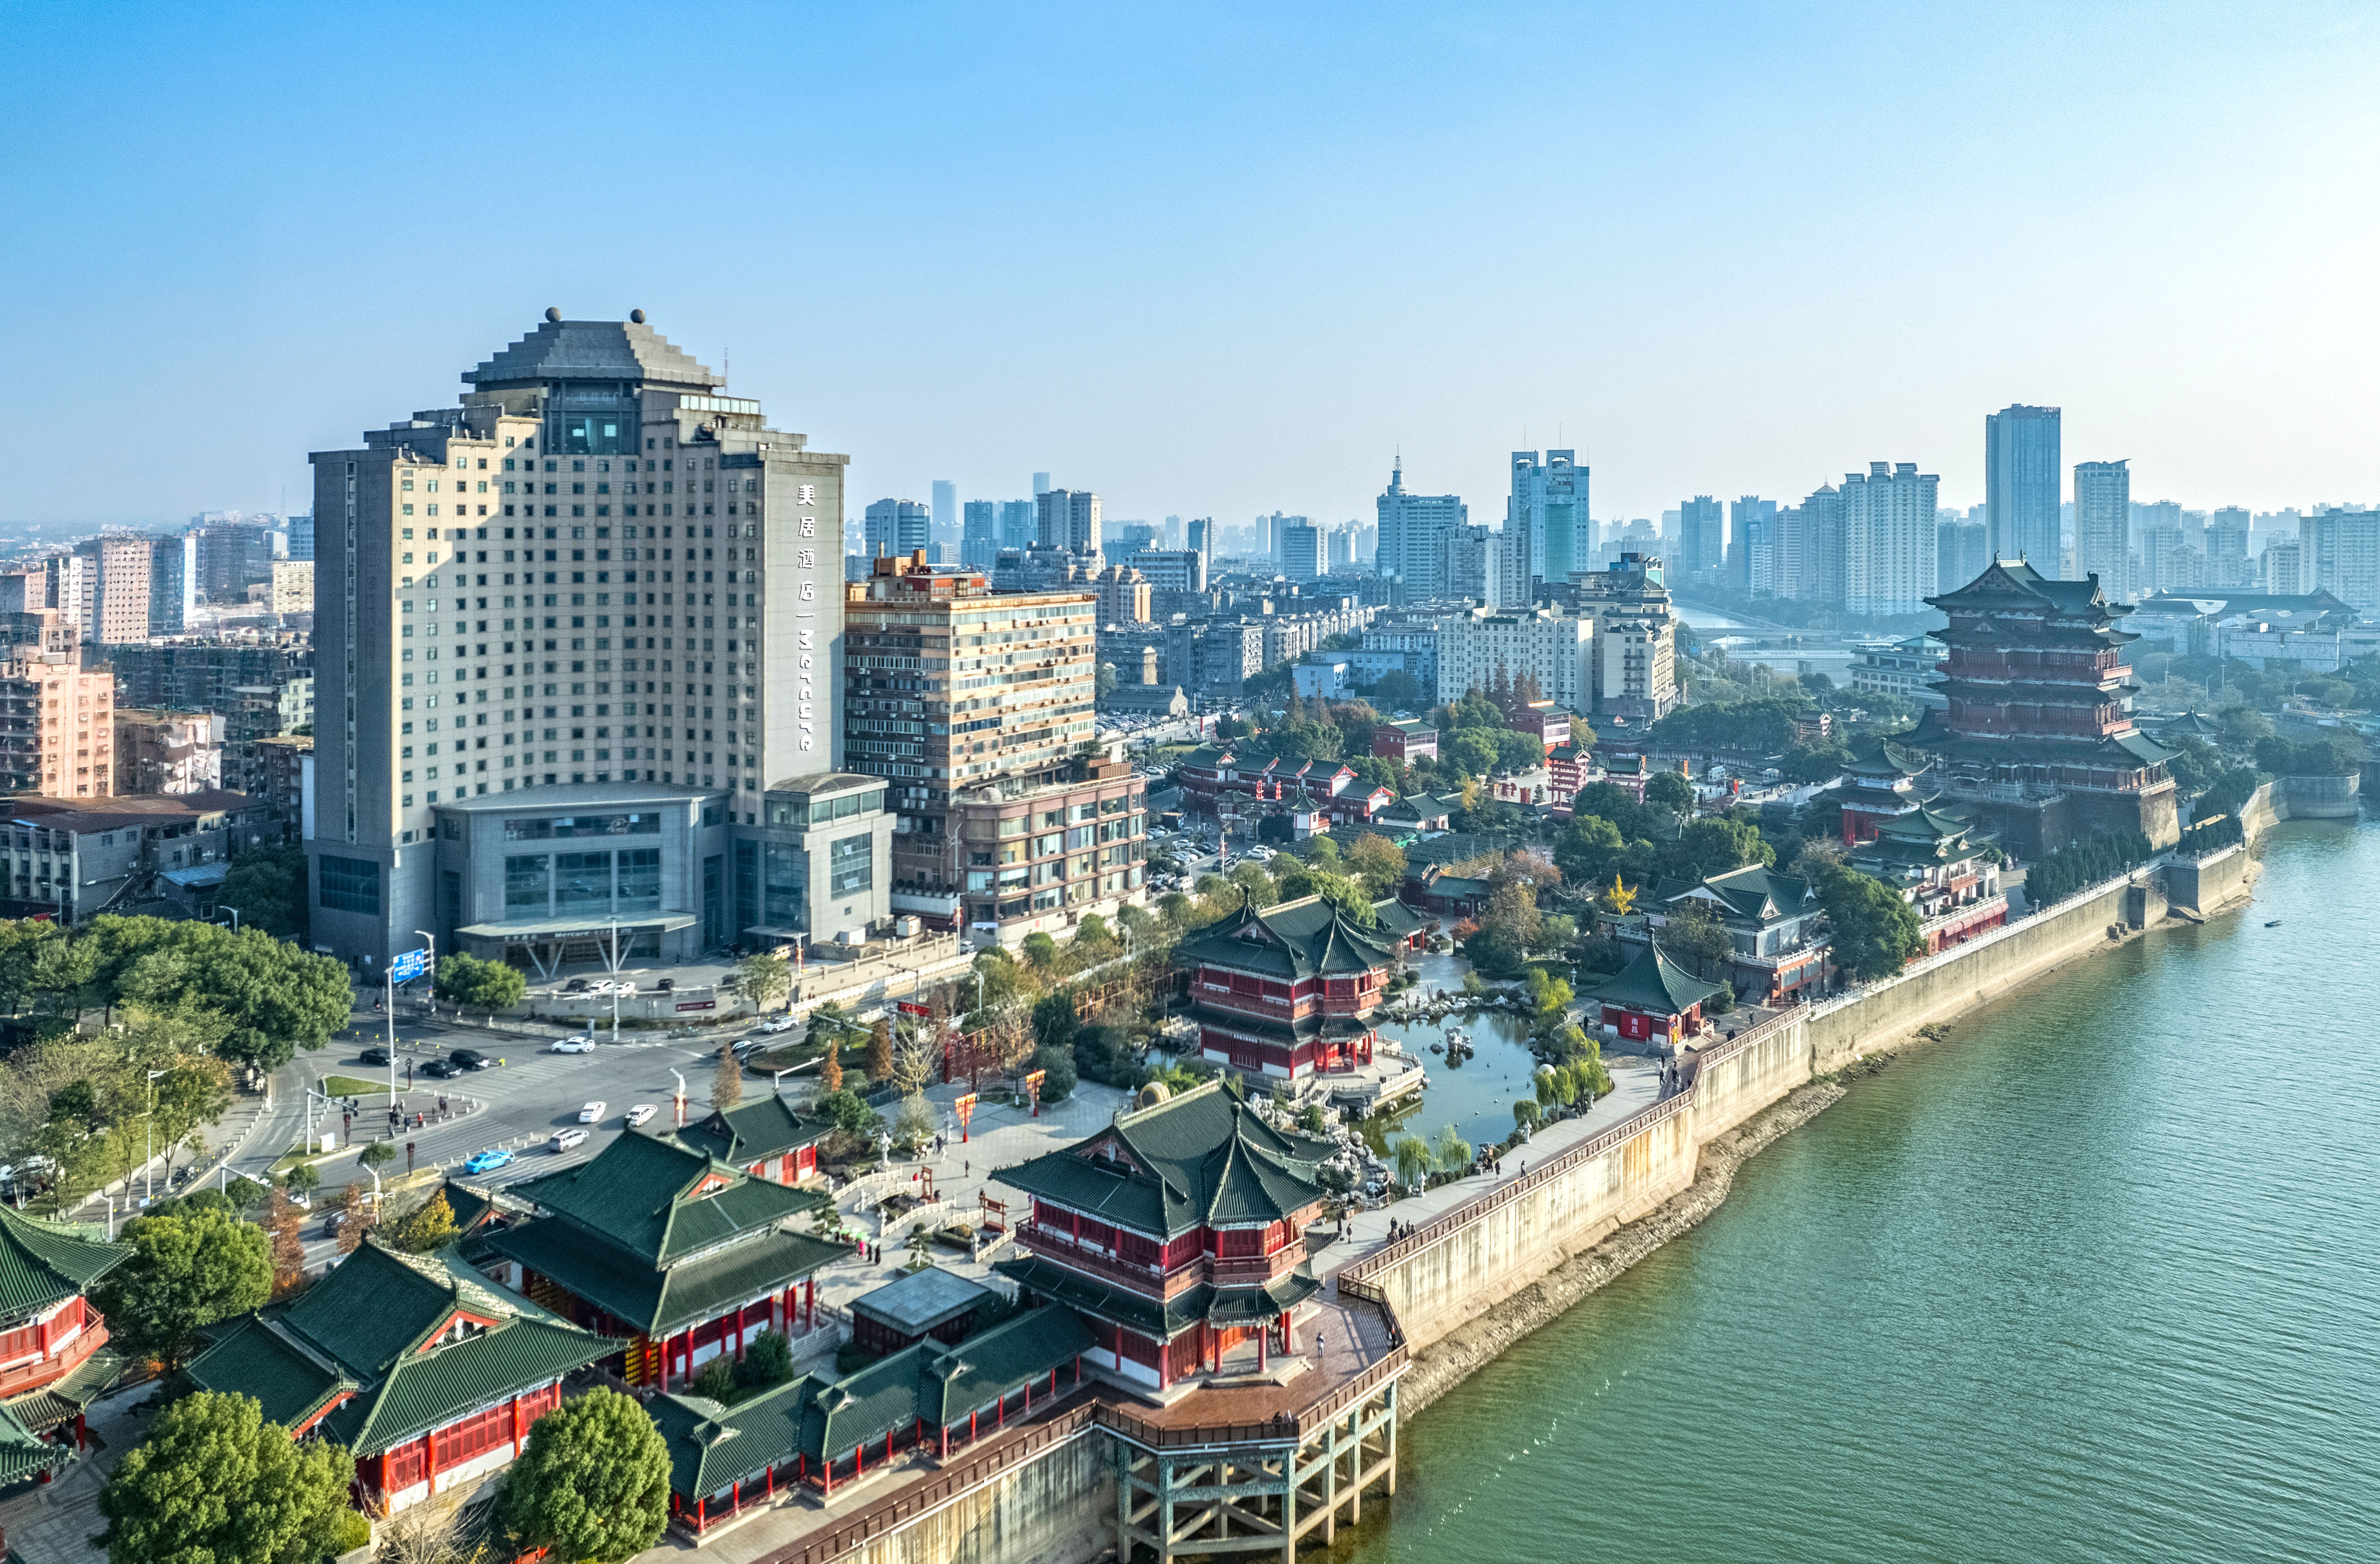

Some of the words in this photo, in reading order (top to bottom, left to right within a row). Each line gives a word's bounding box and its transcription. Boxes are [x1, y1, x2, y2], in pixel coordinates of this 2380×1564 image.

[797, 484, 815, 601] 美居酒店
[799, 629, 814, 751] Mercure
